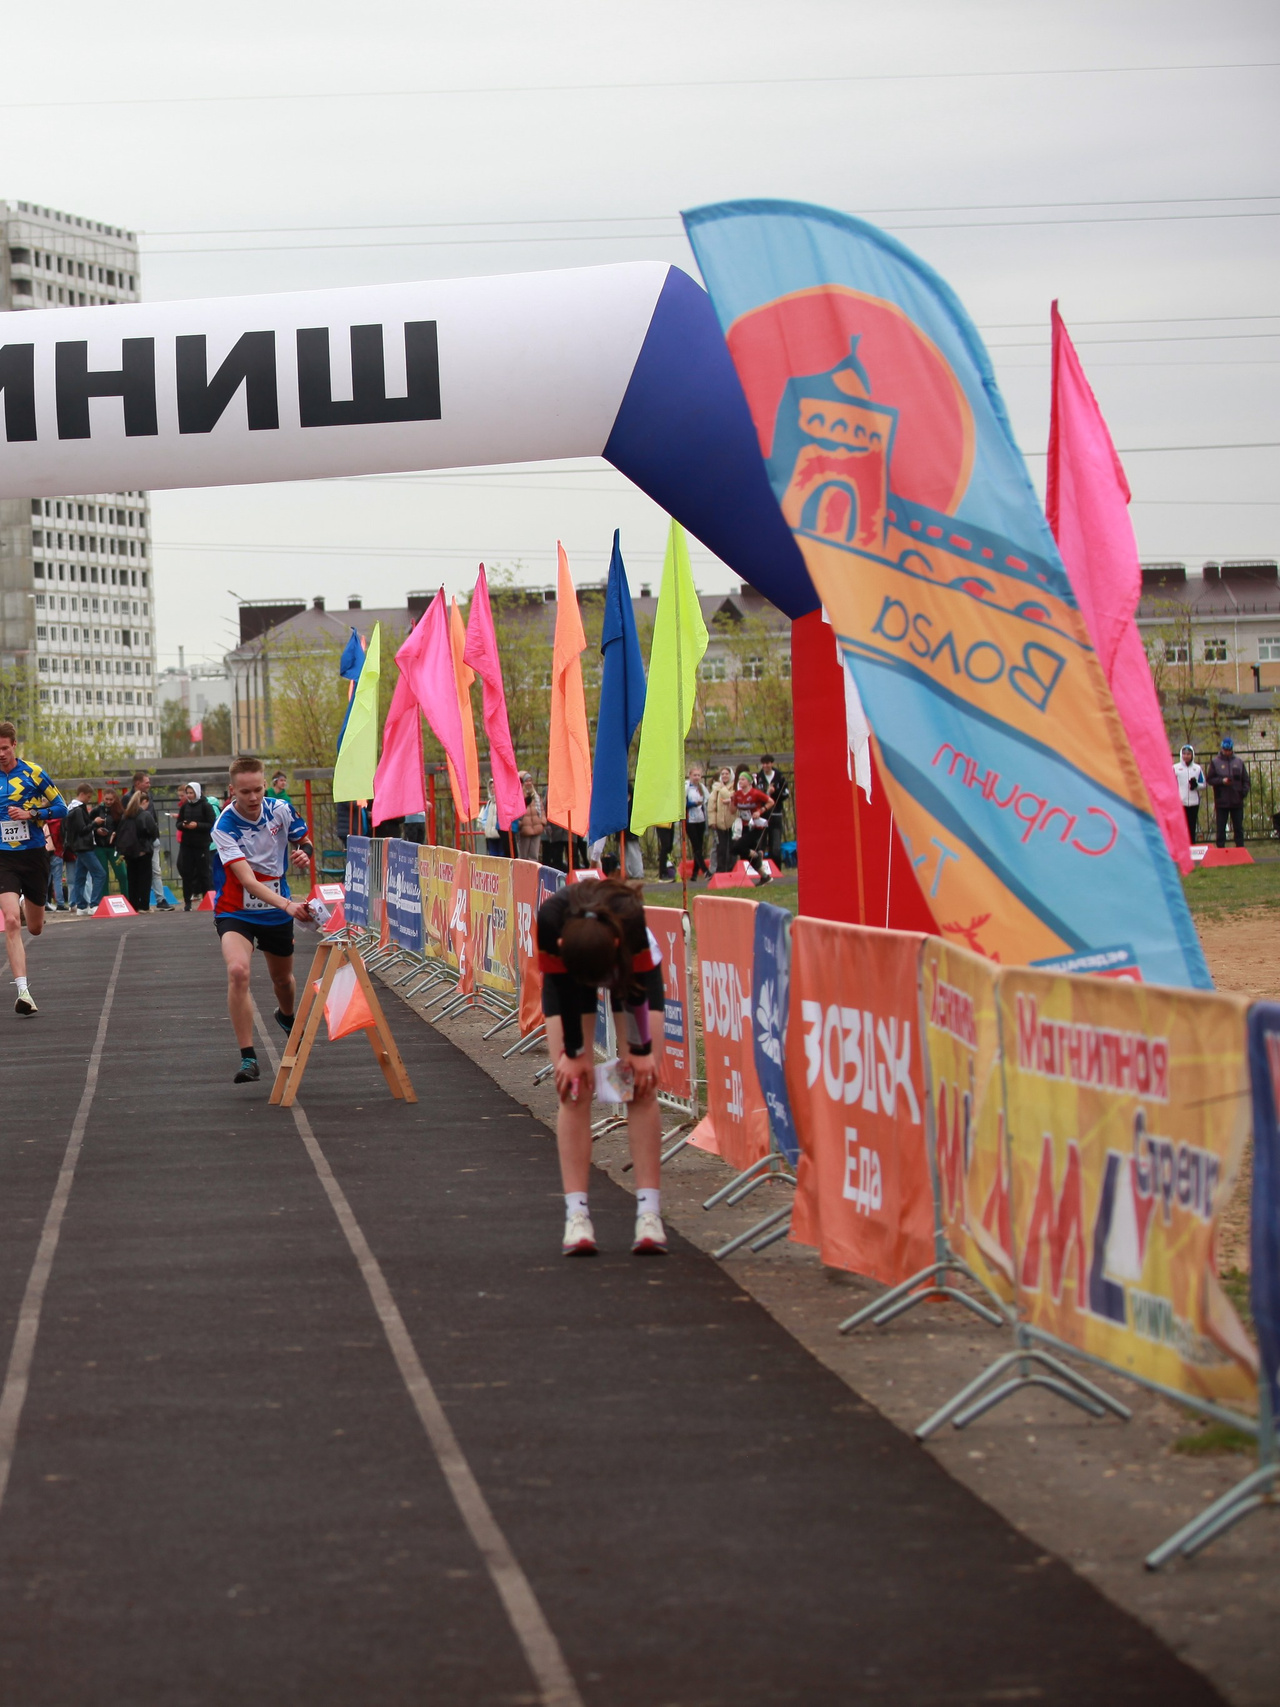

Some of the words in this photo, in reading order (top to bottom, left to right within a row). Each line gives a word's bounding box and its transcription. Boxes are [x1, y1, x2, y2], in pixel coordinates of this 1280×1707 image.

[4, 827, 19, 835] 237
[1015, 992, 1169, 1102] Магнитная
[842, 1126, 883, 1217] Еда
